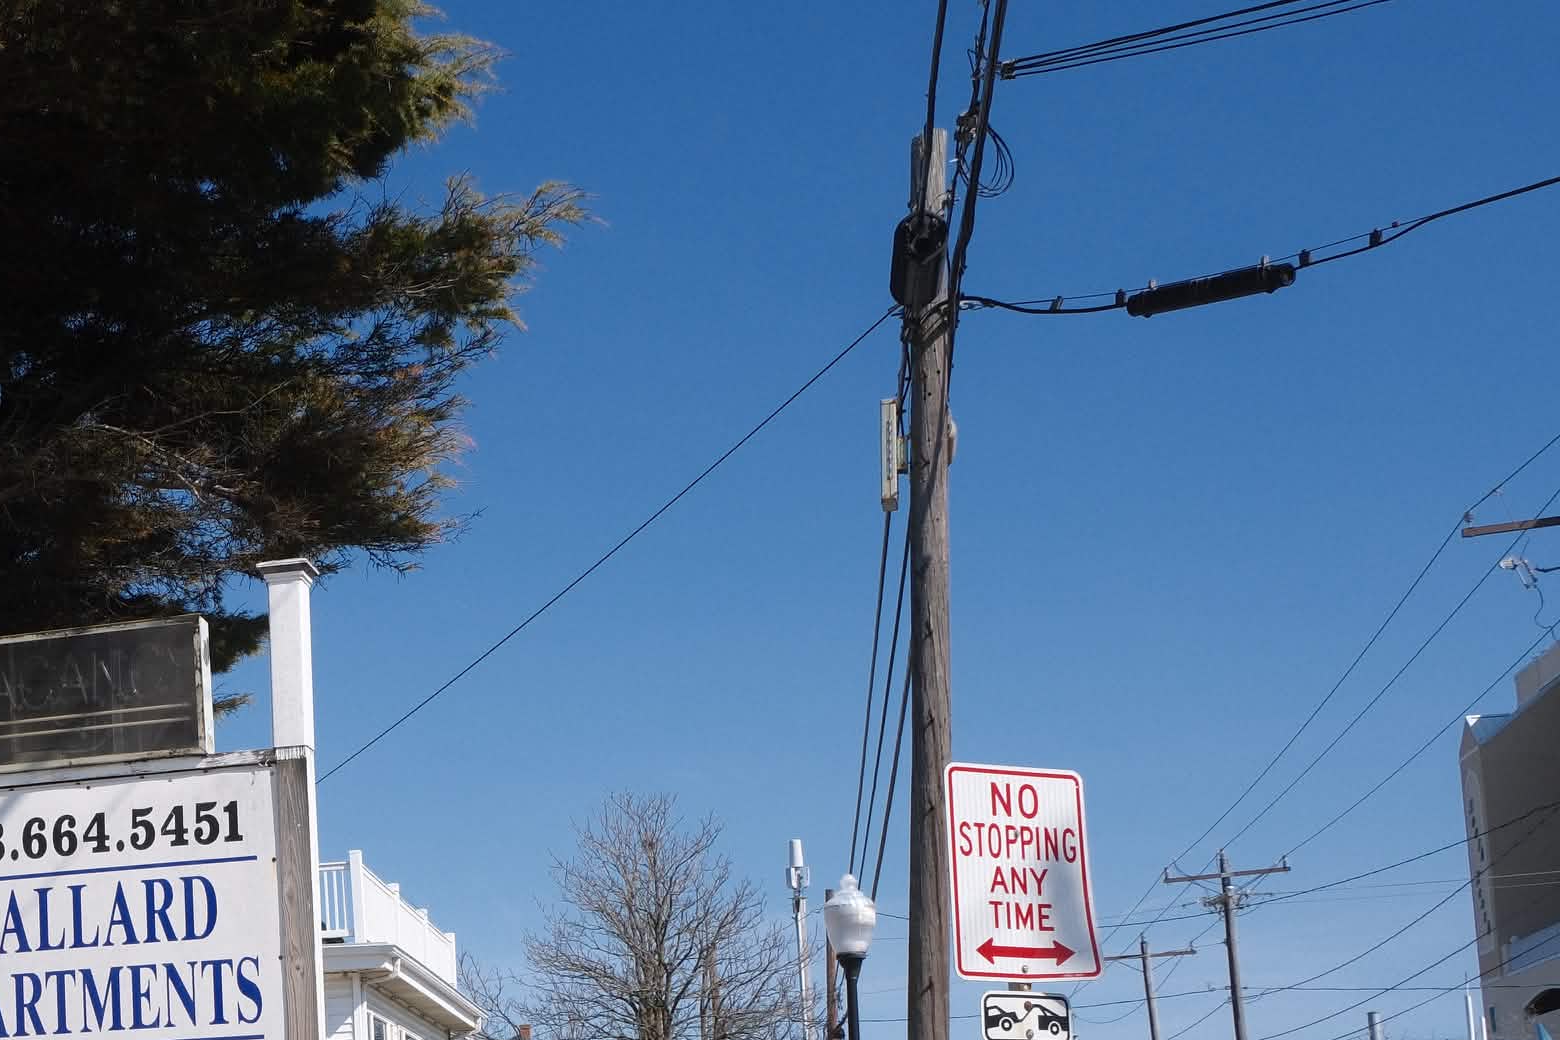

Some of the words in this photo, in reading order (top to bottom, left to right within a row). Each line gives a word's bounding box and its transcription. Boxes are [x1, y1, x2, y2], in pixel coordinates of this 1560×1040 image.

[990, 782, 1039, 820] NO
[959, 820, 1077, 864] STOPPING
[990, 865, 1049, 897] ANY
[989, 900, 1055, 932] TIME
